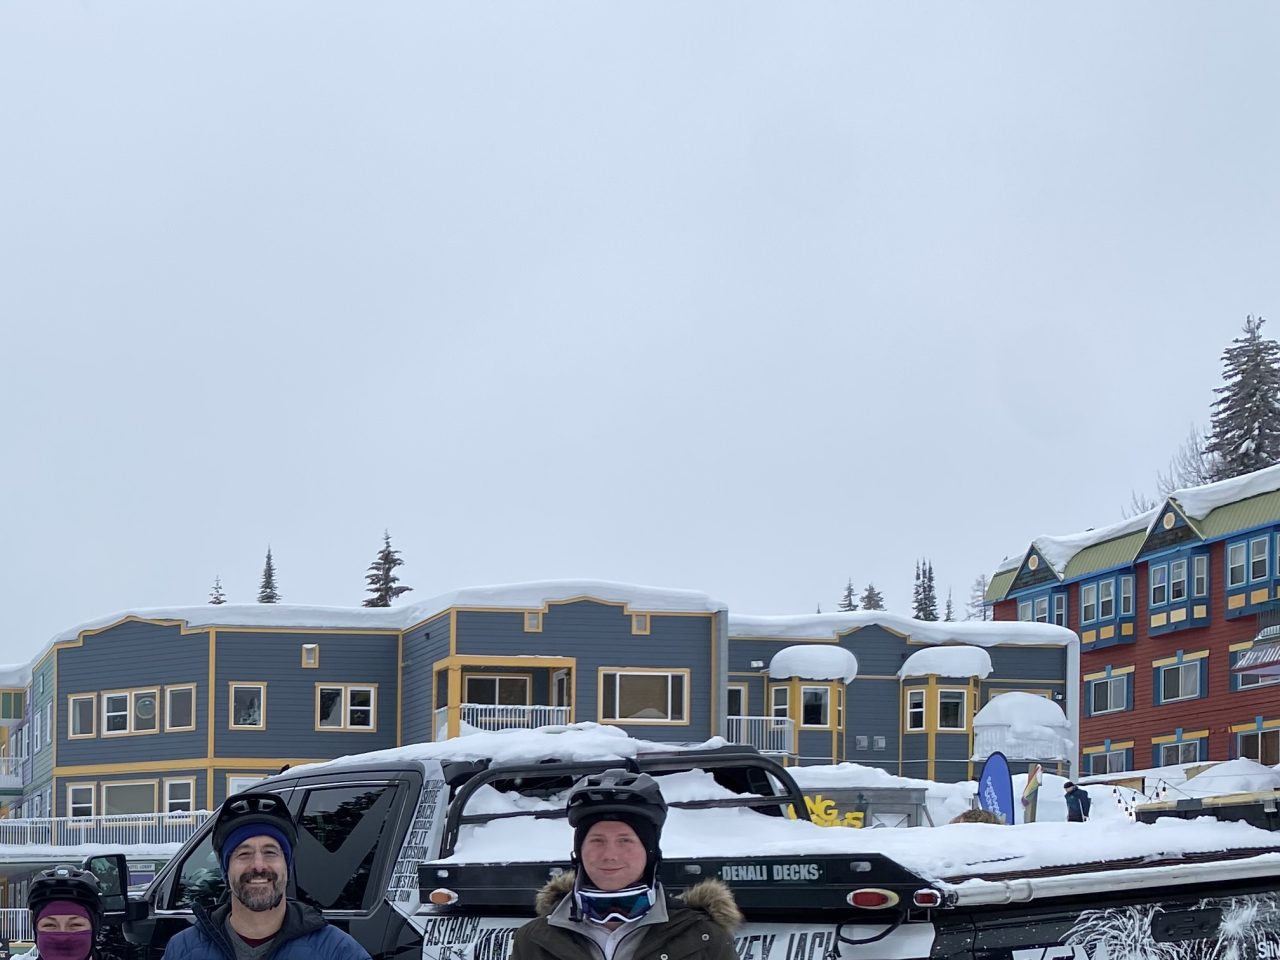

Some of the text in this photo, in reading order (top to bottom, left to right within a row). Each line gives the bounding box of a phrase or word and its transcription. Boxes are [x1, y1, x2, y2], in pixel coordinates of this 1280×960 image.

[395, 861, 419, 875] SOLITUD
[722, 864, 819, 881] DENALI DECKS
